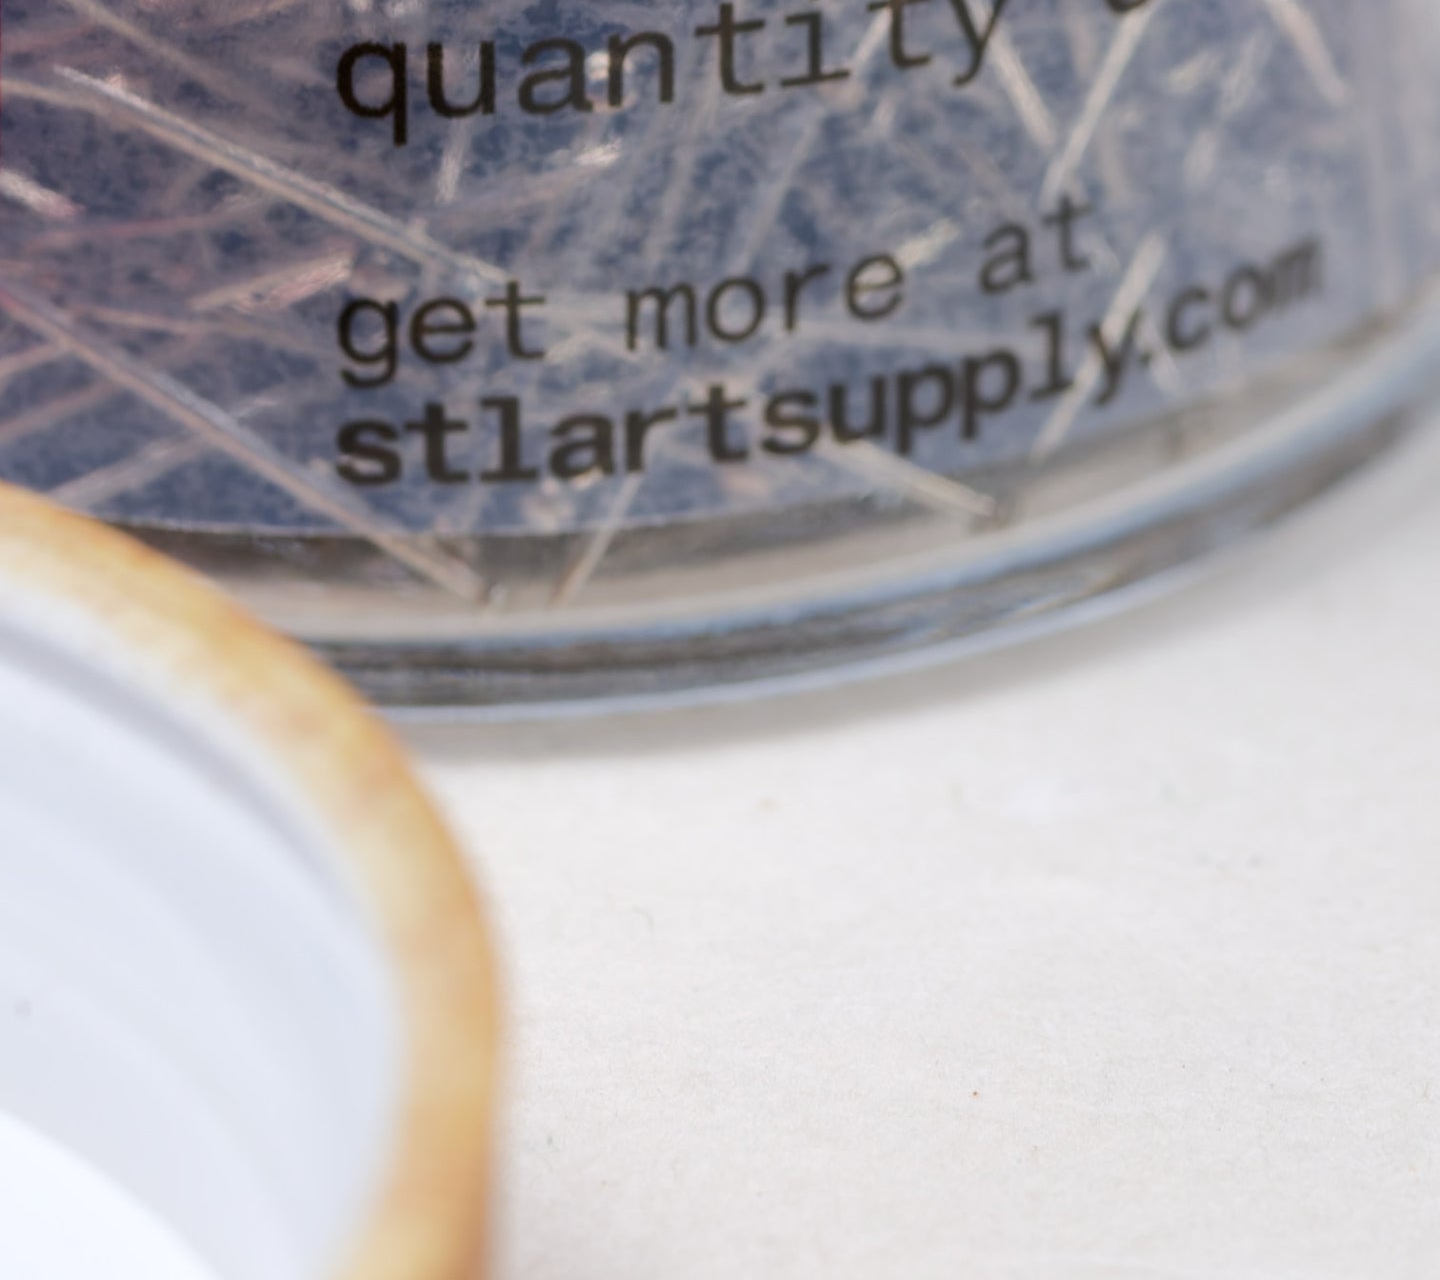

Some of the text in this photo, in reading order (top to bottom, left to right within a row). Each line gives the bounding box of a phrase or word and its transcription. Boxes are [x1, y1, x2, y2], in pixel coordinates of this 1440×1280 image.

[332, 234, 1326, 487] stlartsupply.com
[334, 189, 1095, 389] get more at
